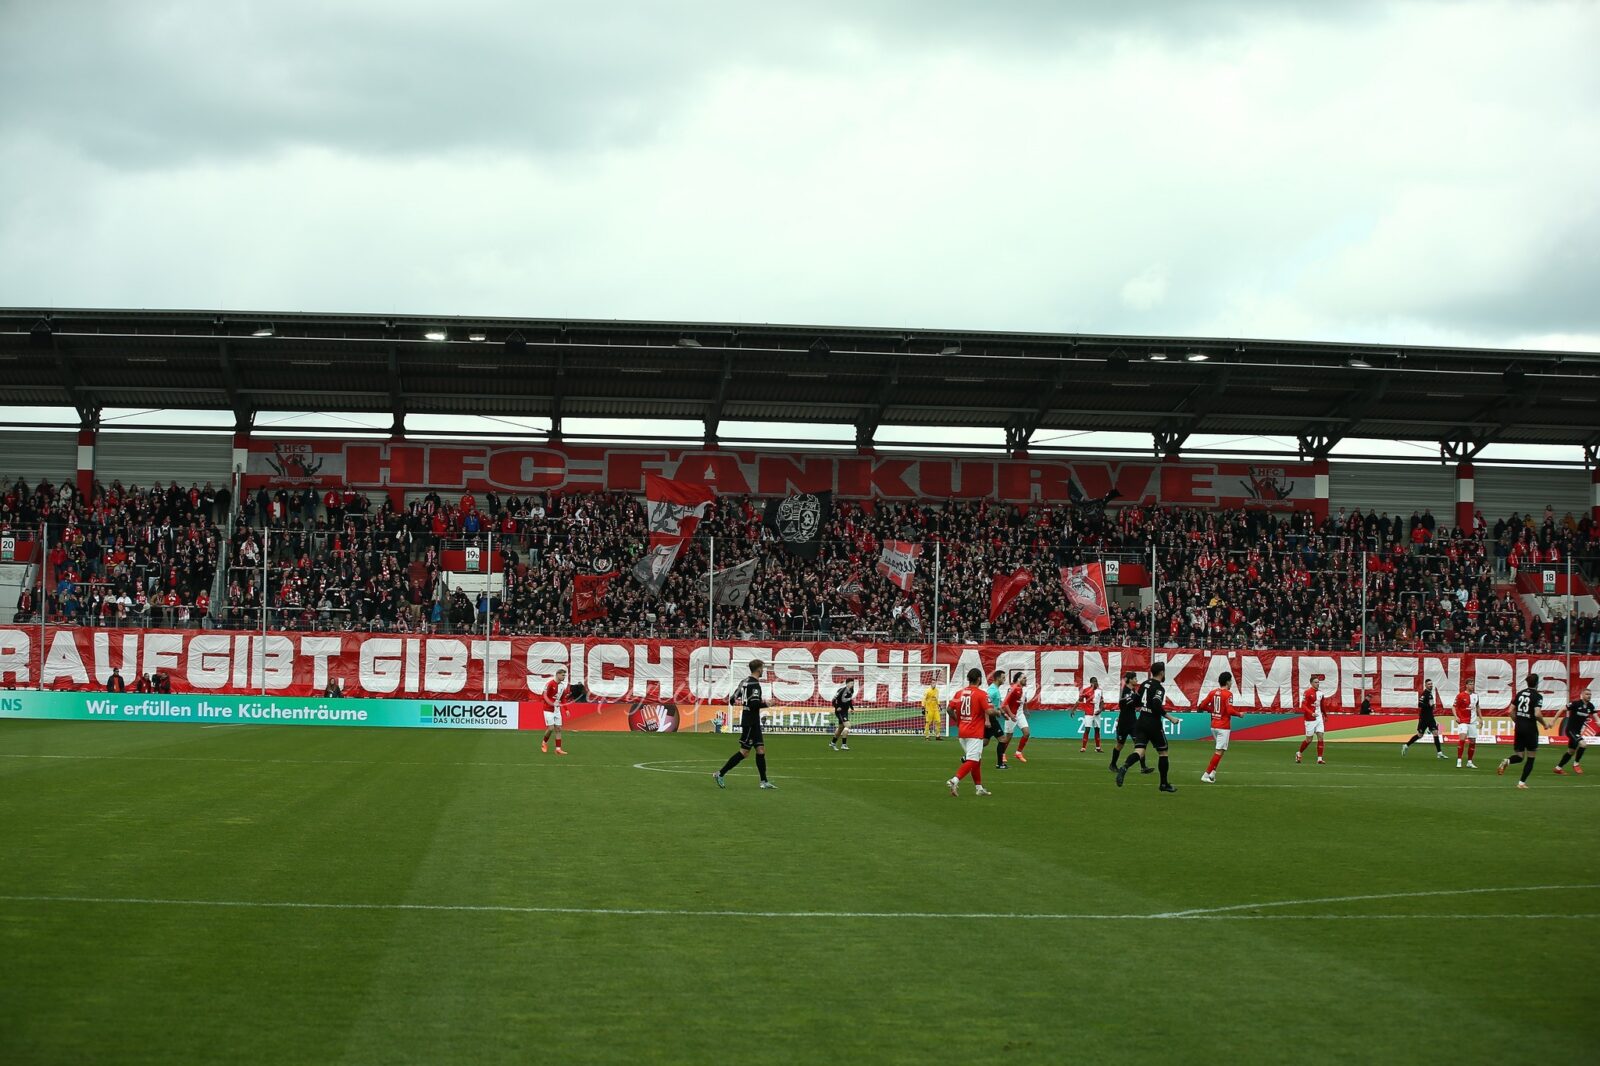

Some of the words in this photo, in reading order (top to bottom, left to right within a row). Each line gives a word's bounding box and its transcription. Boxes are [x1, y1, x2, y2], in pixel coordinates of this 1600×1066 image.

[1258, 468, 1280, 476] HFC
[3, 541, 14, 549] 20
[1545, 573, 1554, 581] 18
[359, 637, 511, 694] GIBT
[527, 642, 674, 699] SICH
[1475, 658, 1568, 711] BIS
[1, 699, 22, 711] NS
[960, 695, 971, 716] 28
[1141, 688, 1148, 707] 4
[1213, 695, 1221, 713] 10
[1517, 695, 1530, 713] 23
[86, 700, 119, 714] Wir
[124, 700, 192, 717] erfüllen
[198, 703, 232, 718] Ihre
[239, 703, 368, 721] Küchenträume
[790, 711, 830, 727] FIVE
